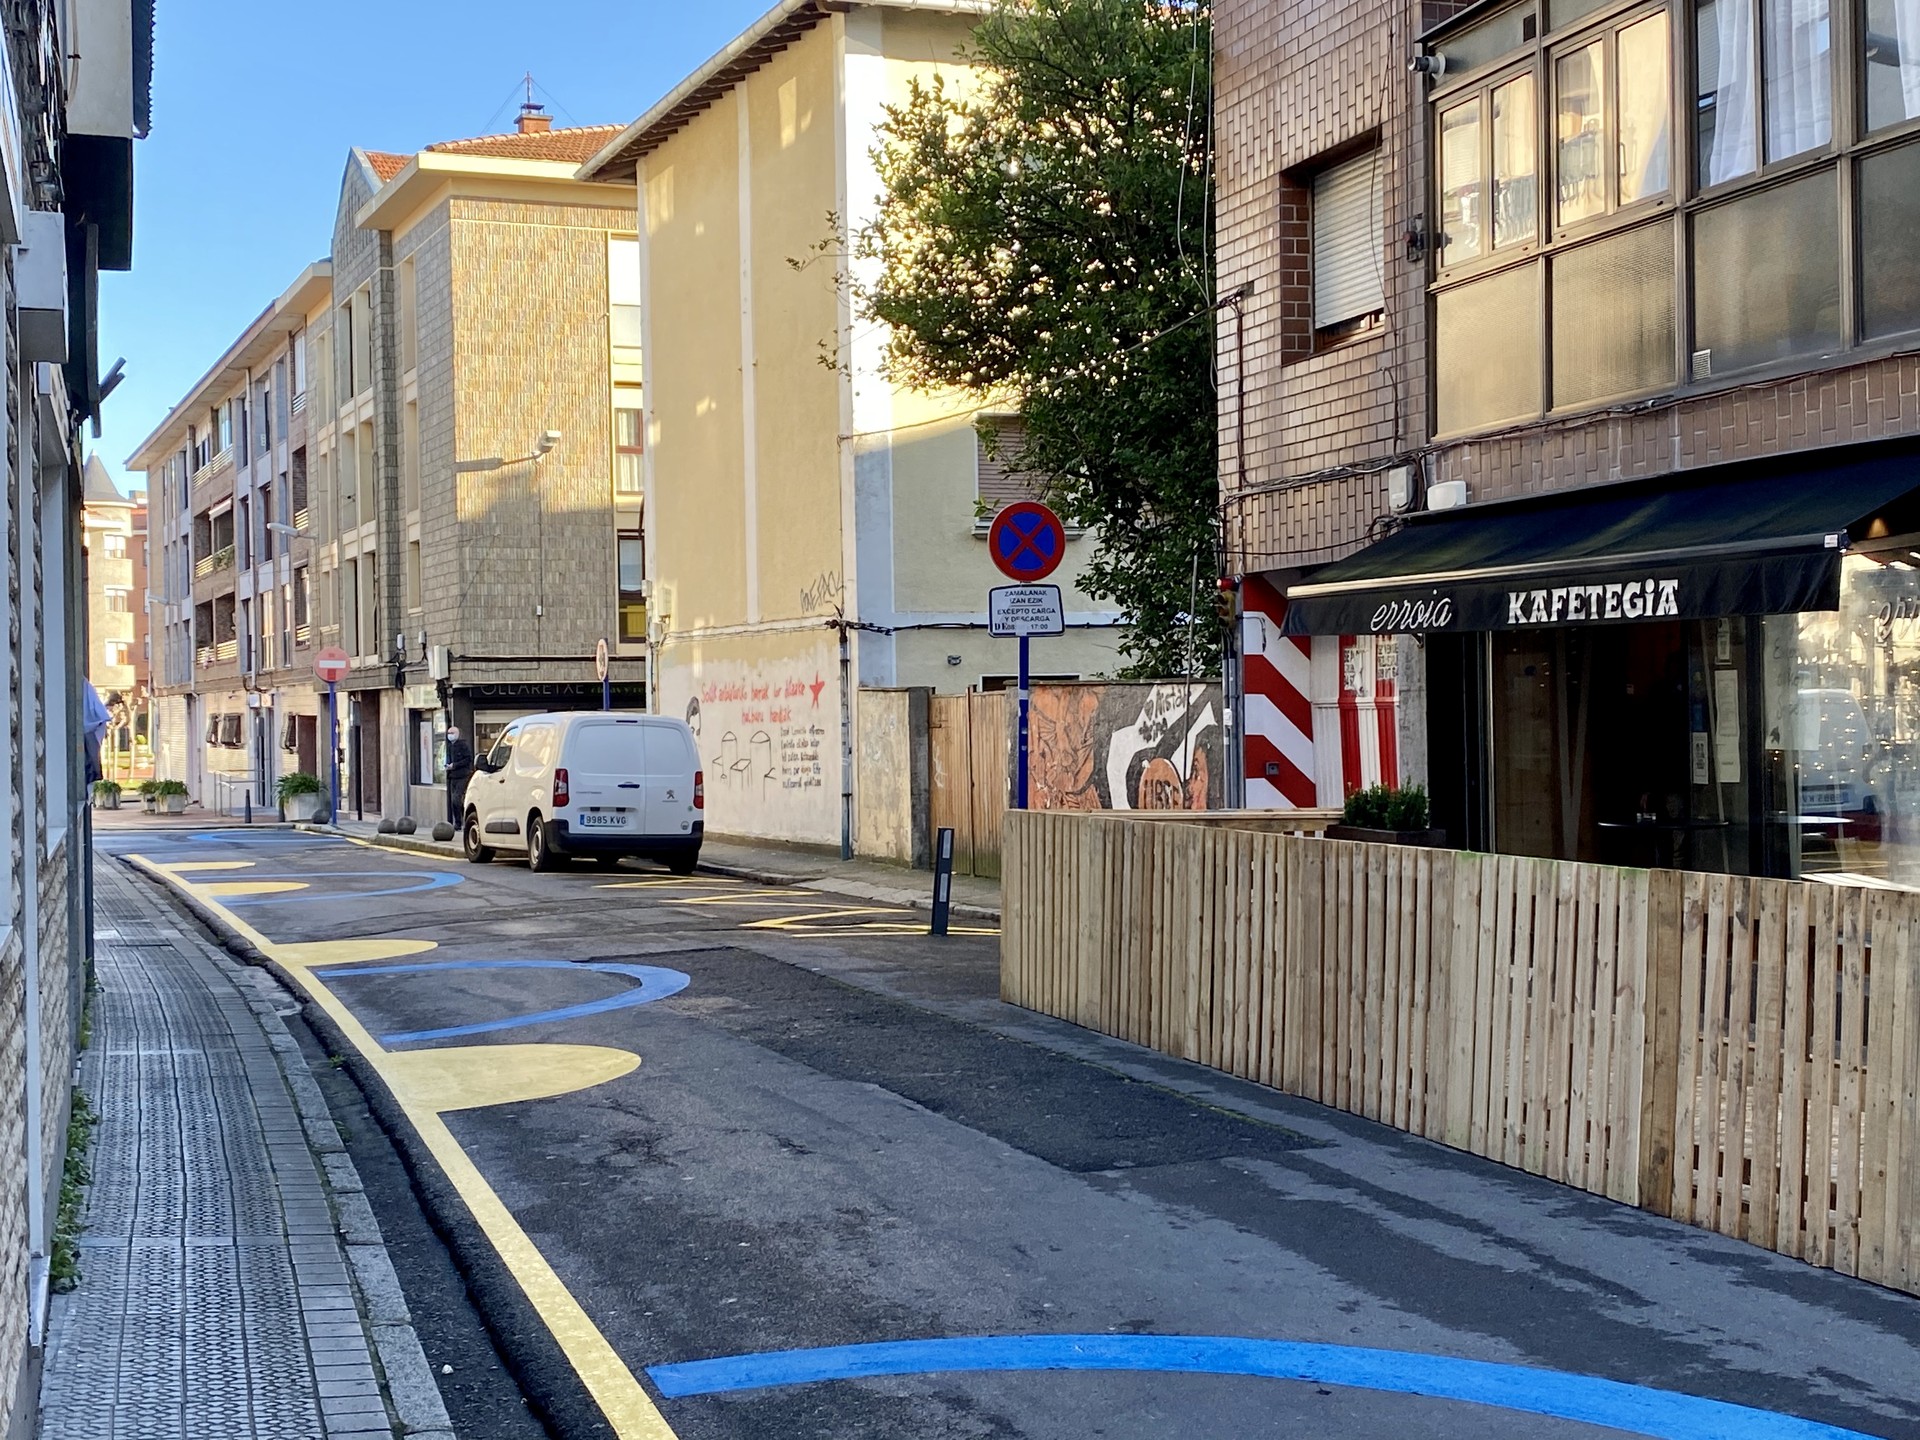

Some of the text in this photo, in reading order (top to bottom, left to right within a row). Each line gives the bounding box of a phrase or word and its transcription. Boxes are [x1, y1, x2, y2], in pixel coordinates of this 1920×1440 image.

[1370, 590, 1453, 632] erroia
[586, 816, 627, 825] 9985 KVG
